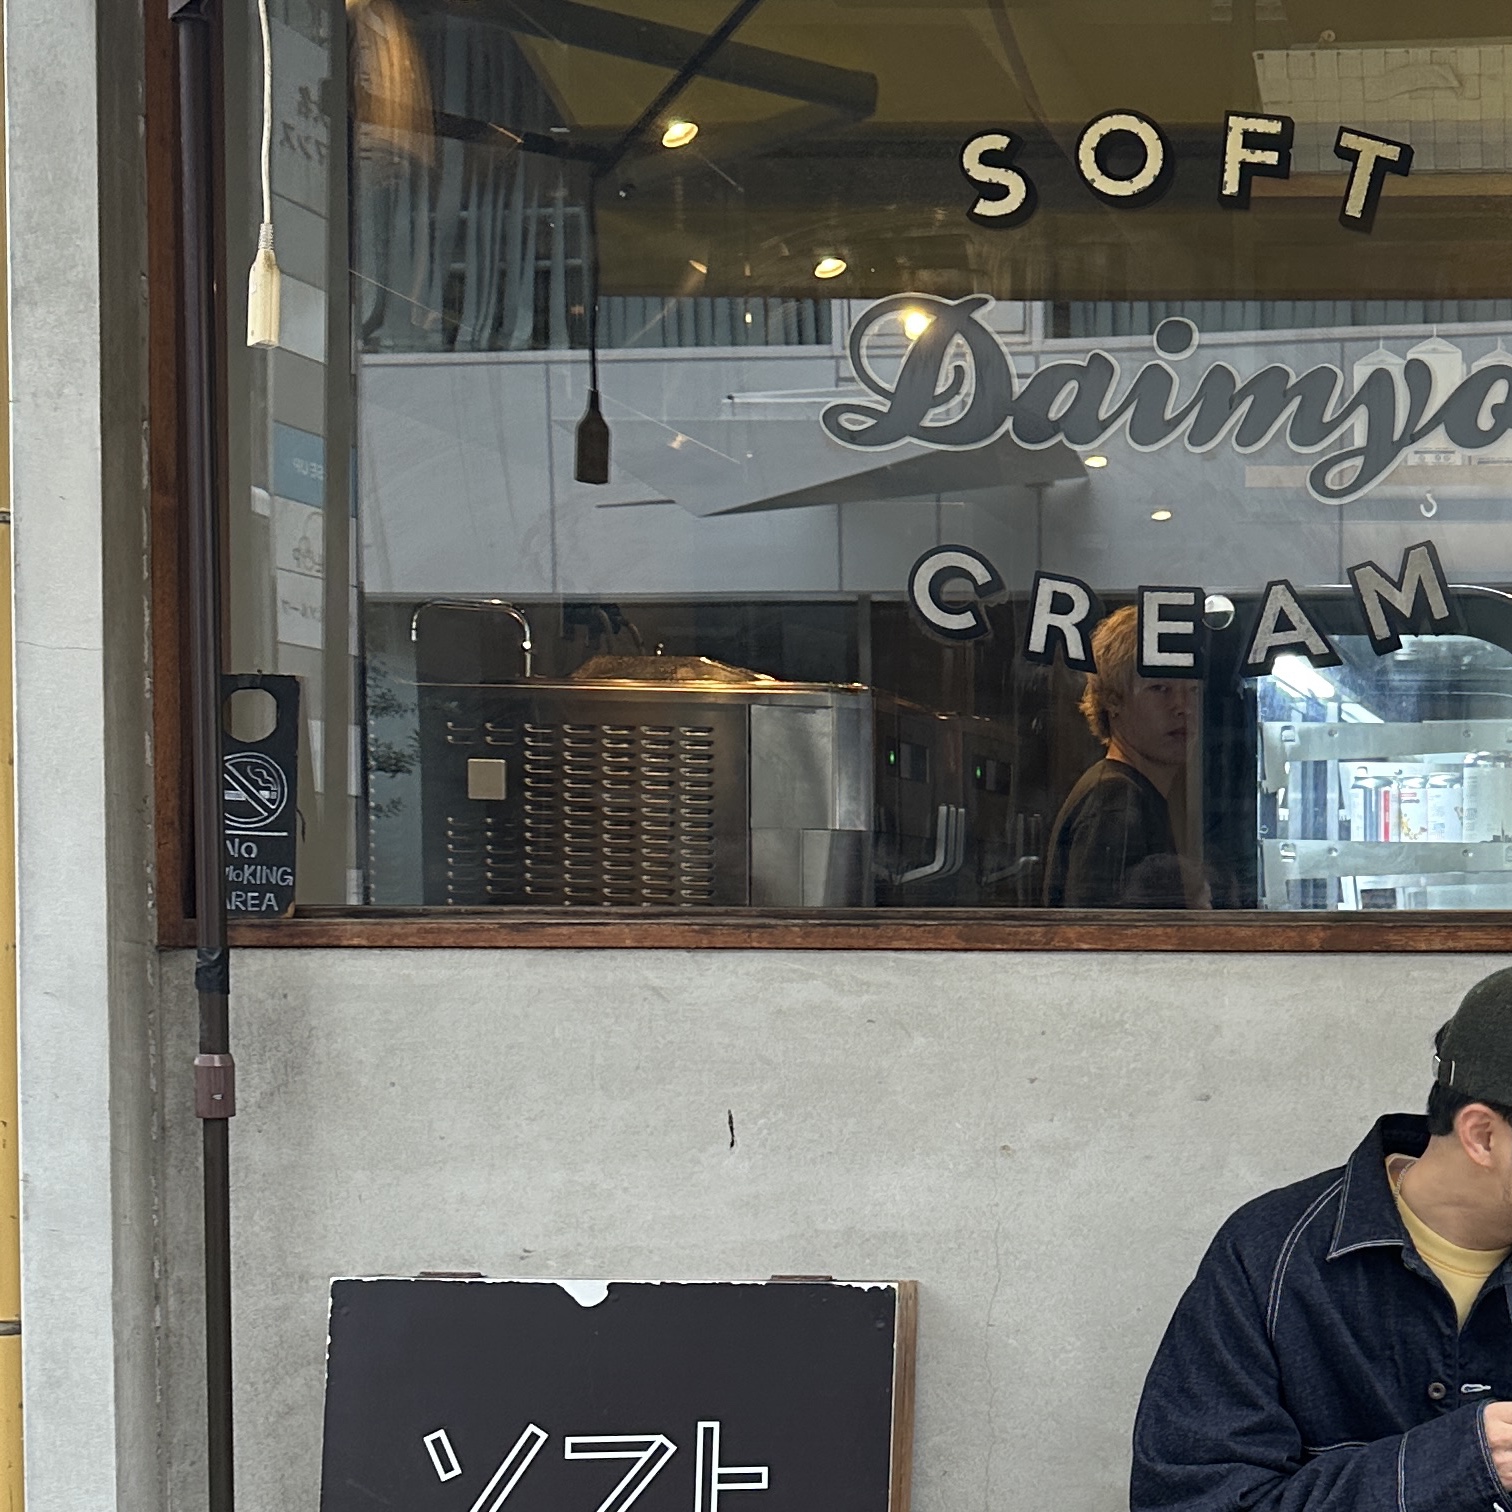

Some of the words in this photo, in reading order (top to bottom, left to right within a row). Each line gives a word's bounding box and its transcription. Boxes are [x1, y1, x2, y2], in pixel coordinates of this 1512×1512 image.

[960, 109, 1413, 232] SOFT
[908, 540, 1461, 679] CREAM
[226, 891, 279, 911] REA
